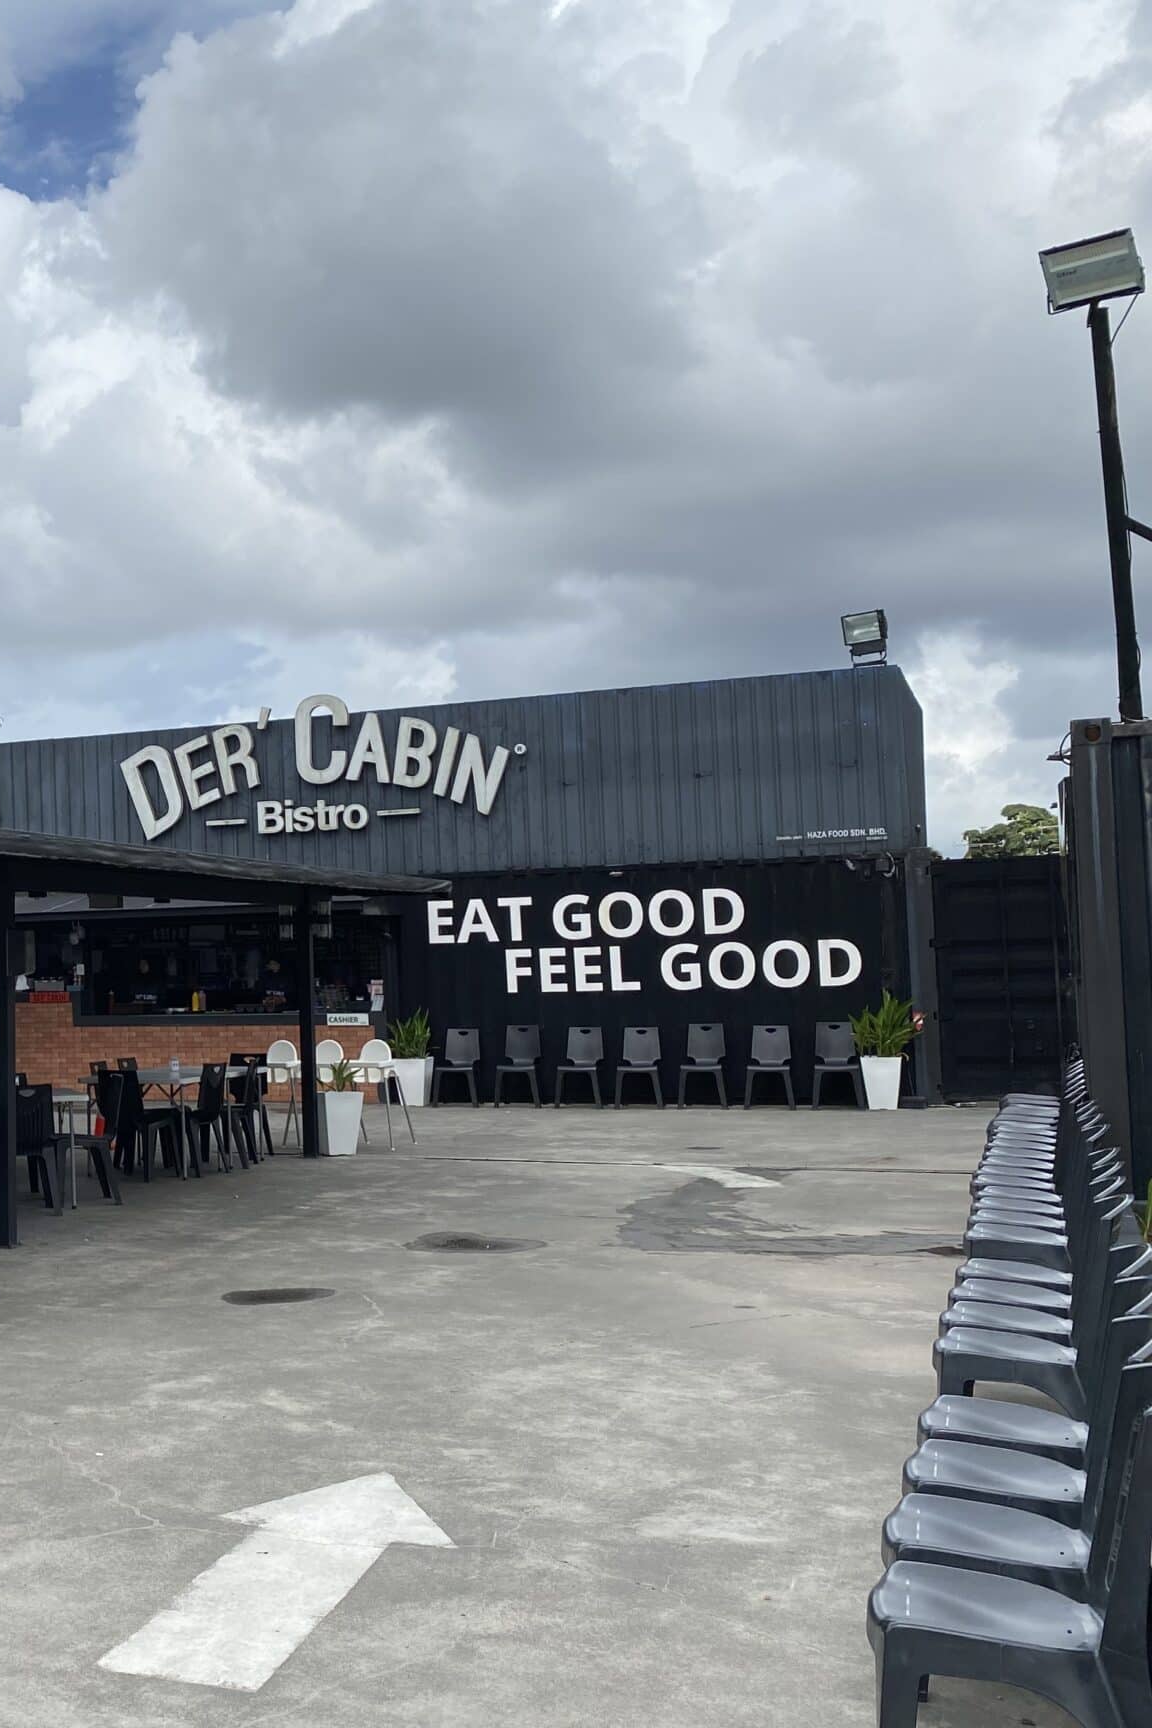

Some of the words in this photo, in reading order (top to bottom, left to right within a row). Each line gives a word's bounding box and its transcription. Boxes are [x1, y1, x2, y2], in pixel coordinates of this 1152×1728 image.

[120, 706, 272, 841] DER'
[294, 694, 510, 816] CABIN
[257, 799, 369, 834] Bistro
[807, 830, 827, 839] HAZA
[828, 829, 849, 838] FOOD
[426, 896, 533, 945] EAT
[552, 887, 745, 941] GOOD
[504, 945, 642, 993] FEEL
[660, 938, 863, 991] GOOD
[328, 1015, 359, 1024] CASHIER
